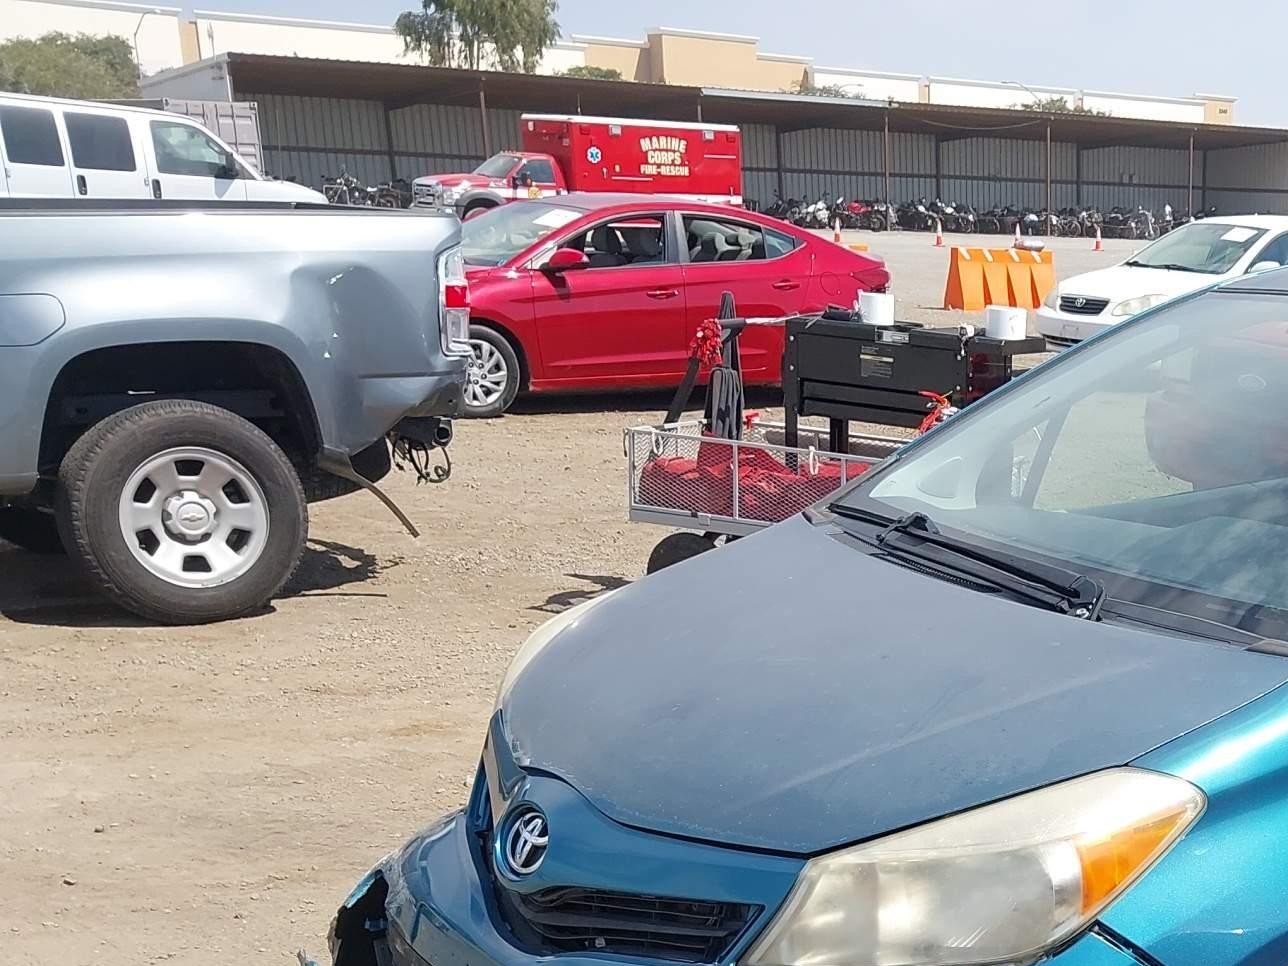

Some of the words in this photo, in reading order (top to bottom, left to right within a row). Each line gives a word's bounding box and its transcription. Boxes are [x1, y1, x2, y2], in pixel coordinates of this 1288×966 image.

[639, 135, 688, 153] MARINE
[647, 150, 682, 165] CORPS
[640, 164, 690, 177] FIRE-RESCUE
